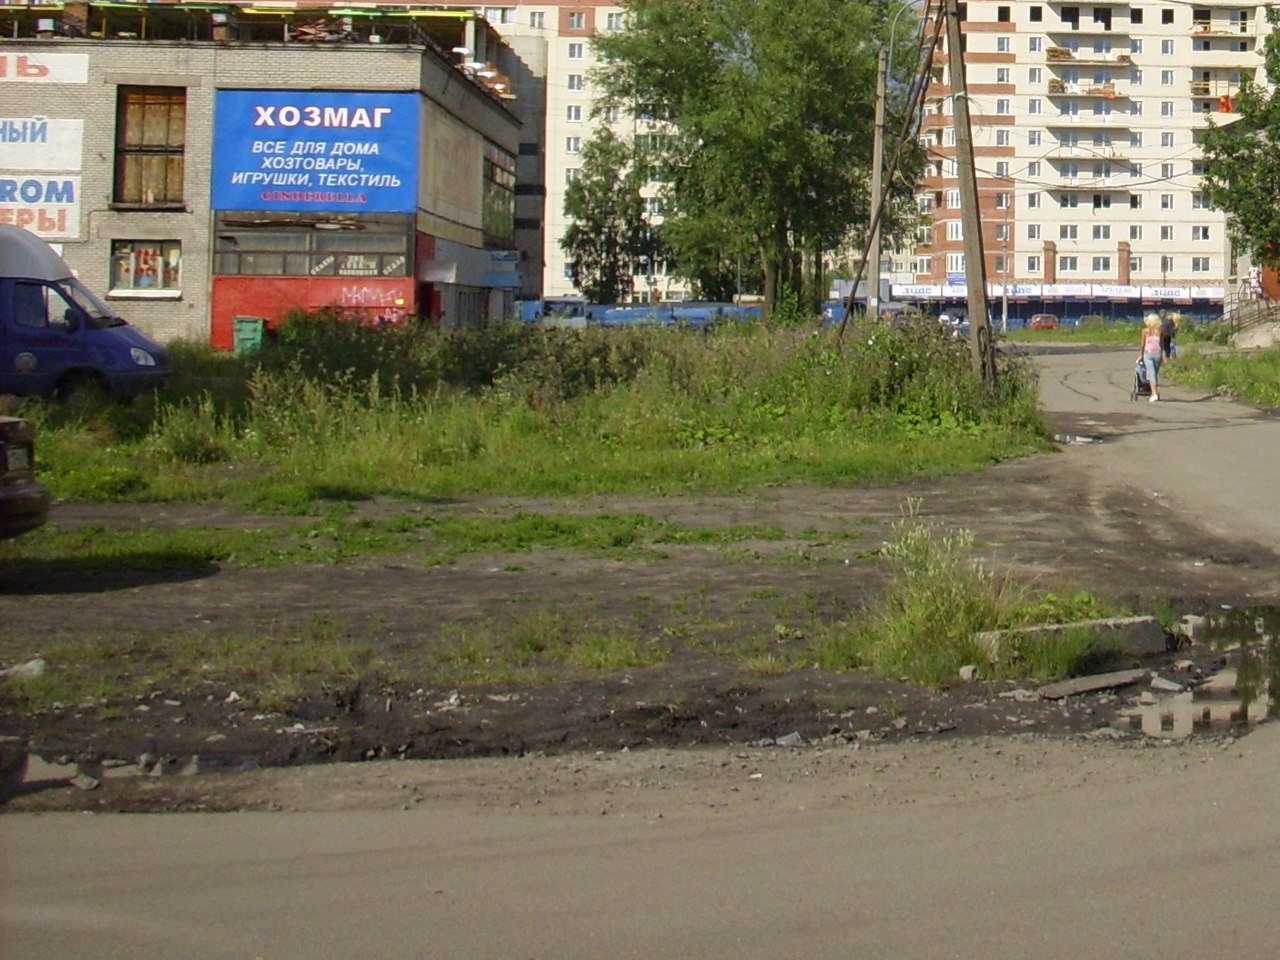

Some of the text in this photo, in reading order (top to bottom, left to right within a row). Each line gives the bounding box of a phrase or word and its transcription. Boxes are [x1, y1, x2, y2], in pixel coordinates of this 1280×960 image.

[254, 106, 391, 128] ХОЗМАГ
[252, 141, 379, 155] ВСЕ ДЛЯ ДОМА
[261, 157, 364, 172] ХОЗТОВАРЫ,
[231, 172, 401, 188] ИГРУШКИ, ТЕКСТИЛЬ
